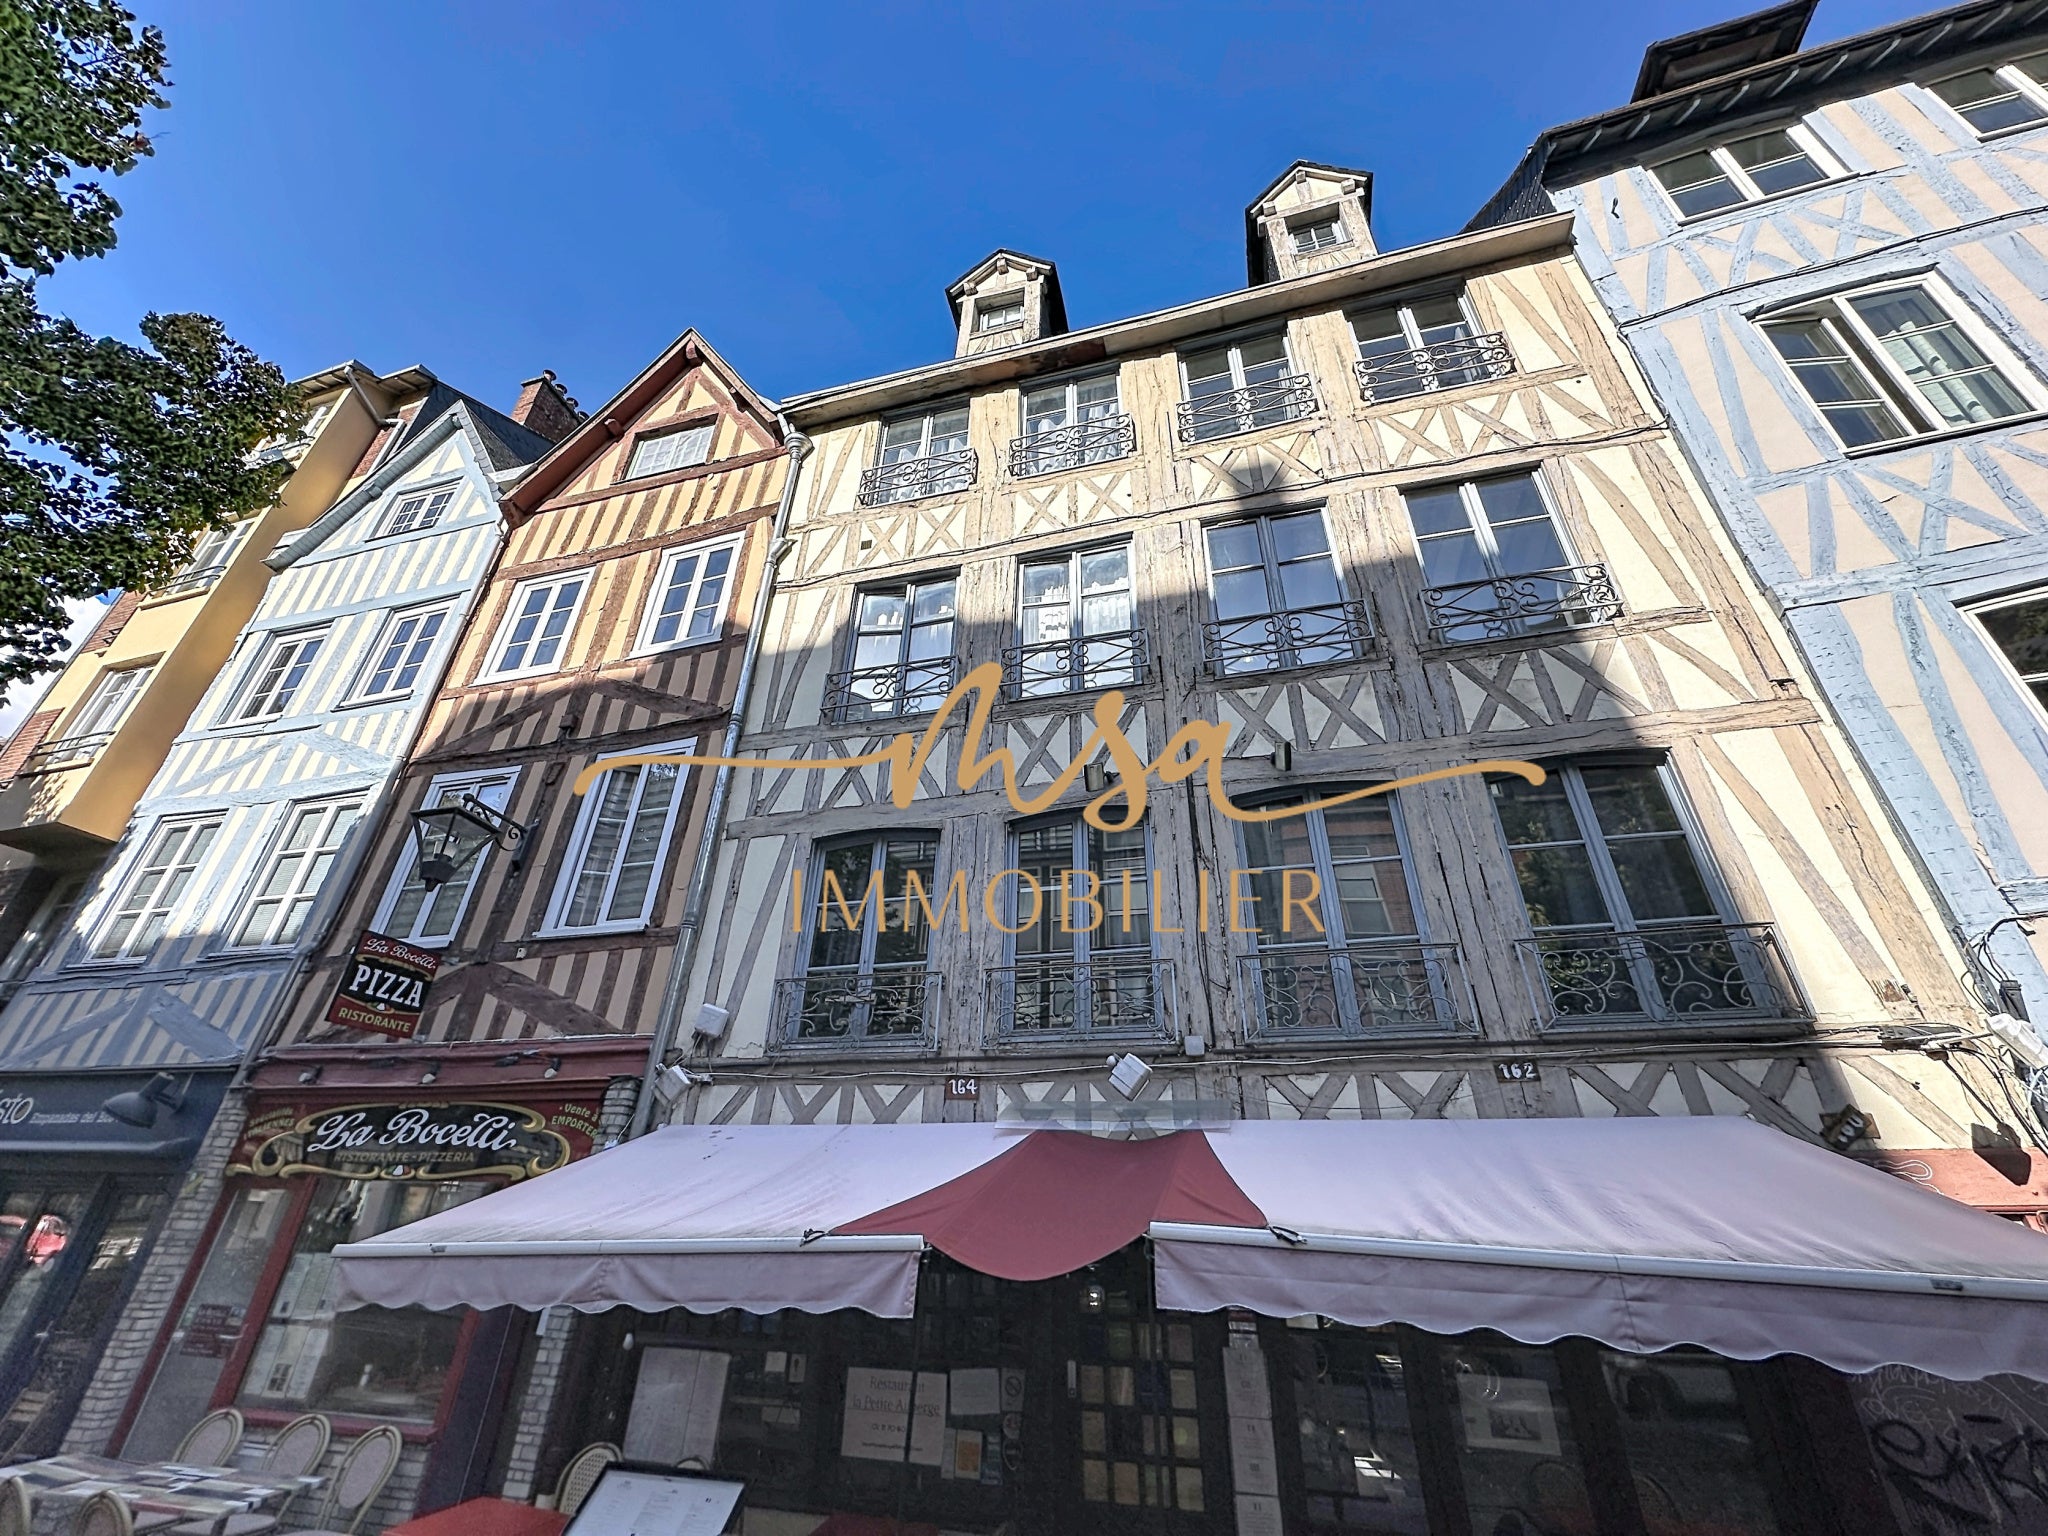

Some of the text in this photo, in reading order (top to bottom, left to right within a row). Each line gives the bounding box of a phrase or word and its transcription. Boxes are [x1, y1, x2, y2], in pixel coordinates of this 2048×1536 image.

[364, 939, 436, 969] La Bocelli
[349, 964, 424, 1008] PIZZA
[338, 1007, 411, 1033] RISTORANTE
[1498, 1062, 1537, 1079] 162
[949, 1079, 978, 1095] 164
[564, 1103, 591, 1118] Vente
[307, 1109, 517, 1152] La Bocelli
[551, 1115, 598, 1138] EMPORTER
[870, 1376, 925, 1393] Restaurt
[896, 1400, 941, 1417] Aerge
